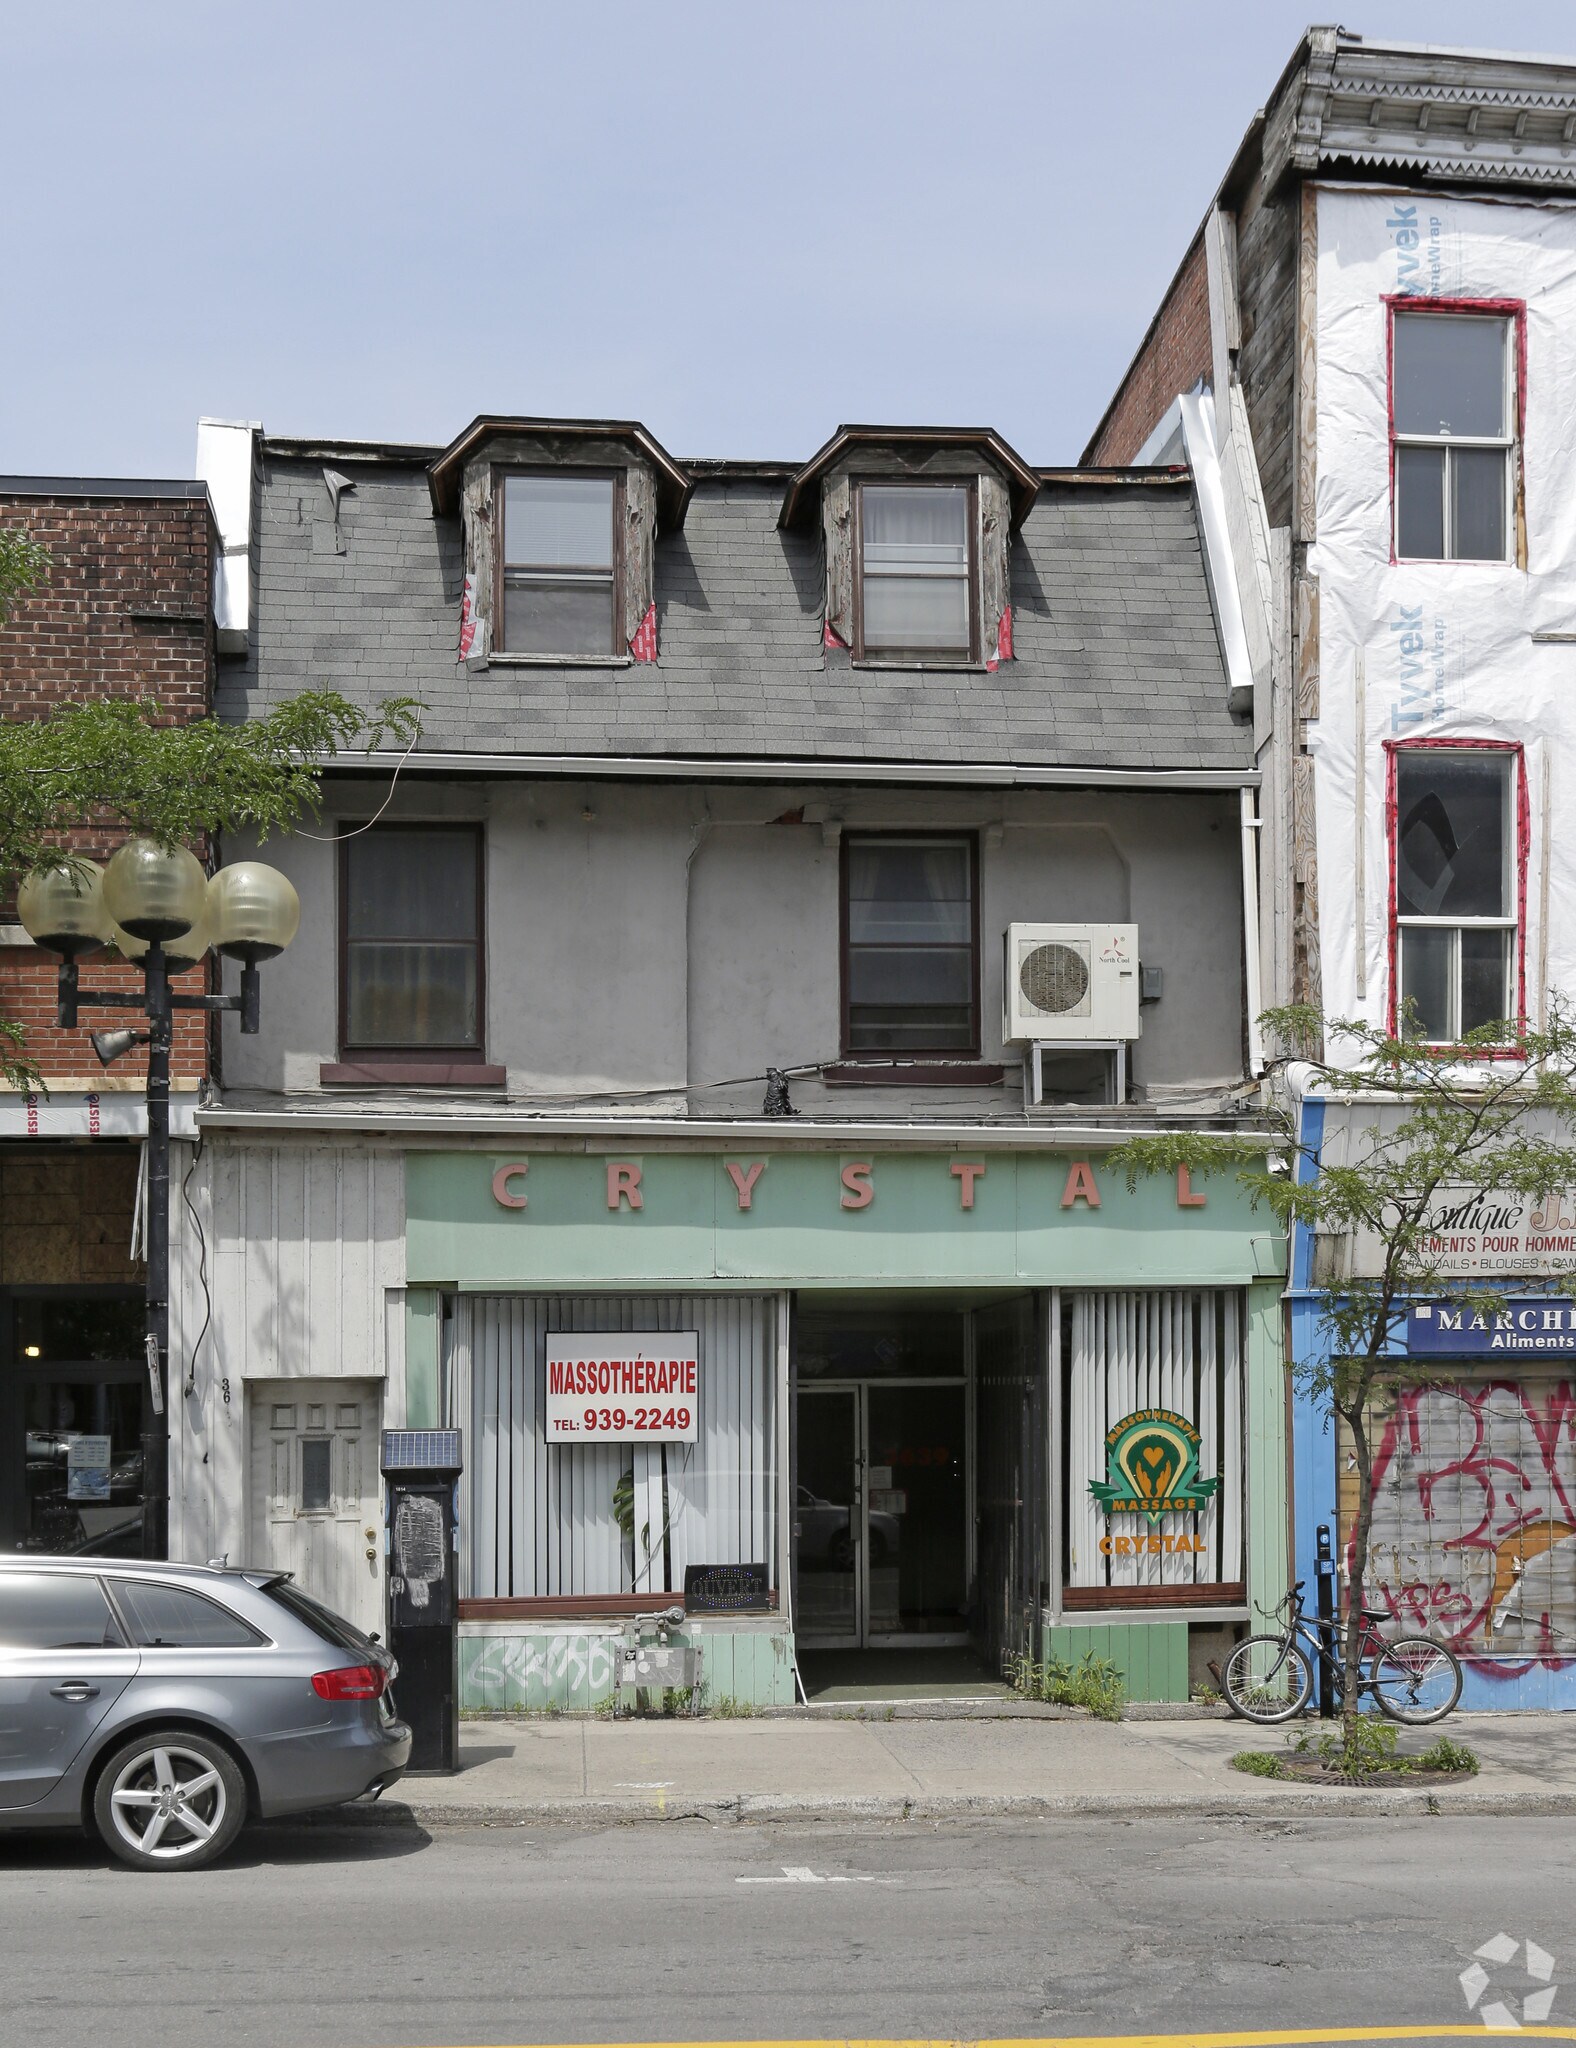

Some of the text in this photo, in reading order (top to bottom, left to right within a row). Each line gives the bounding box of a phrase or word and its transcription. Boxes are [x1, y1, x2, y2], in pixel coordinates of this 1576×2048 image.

[1390, 604, 1431, 732] Tyvek
[1431, 618, 1446, 721] HomeWrap
[492, 1162, 1206, 1209] CRYSTAL
[1404, 1235, 1476, 1253] TEMENTS
[1482, 1236, 1519, 1252] POUR
[1400, 1258, 1470, 1270] HANDAILS
[1480, 1258, 1538, 1270] BLOUSES
[1491, 1333, 1575, 1349] Aliments
[550, 1353, 696, 1395] MASSOTHÉRAPIE
[583, 1408, 691, 1431] 939-2249
[1112, 1498, 1196, 1512] MASSAGE
[1098, 1534, 1207, 1556] CRYSTAL
[691, 1577, 763, 1598] OUVERT
